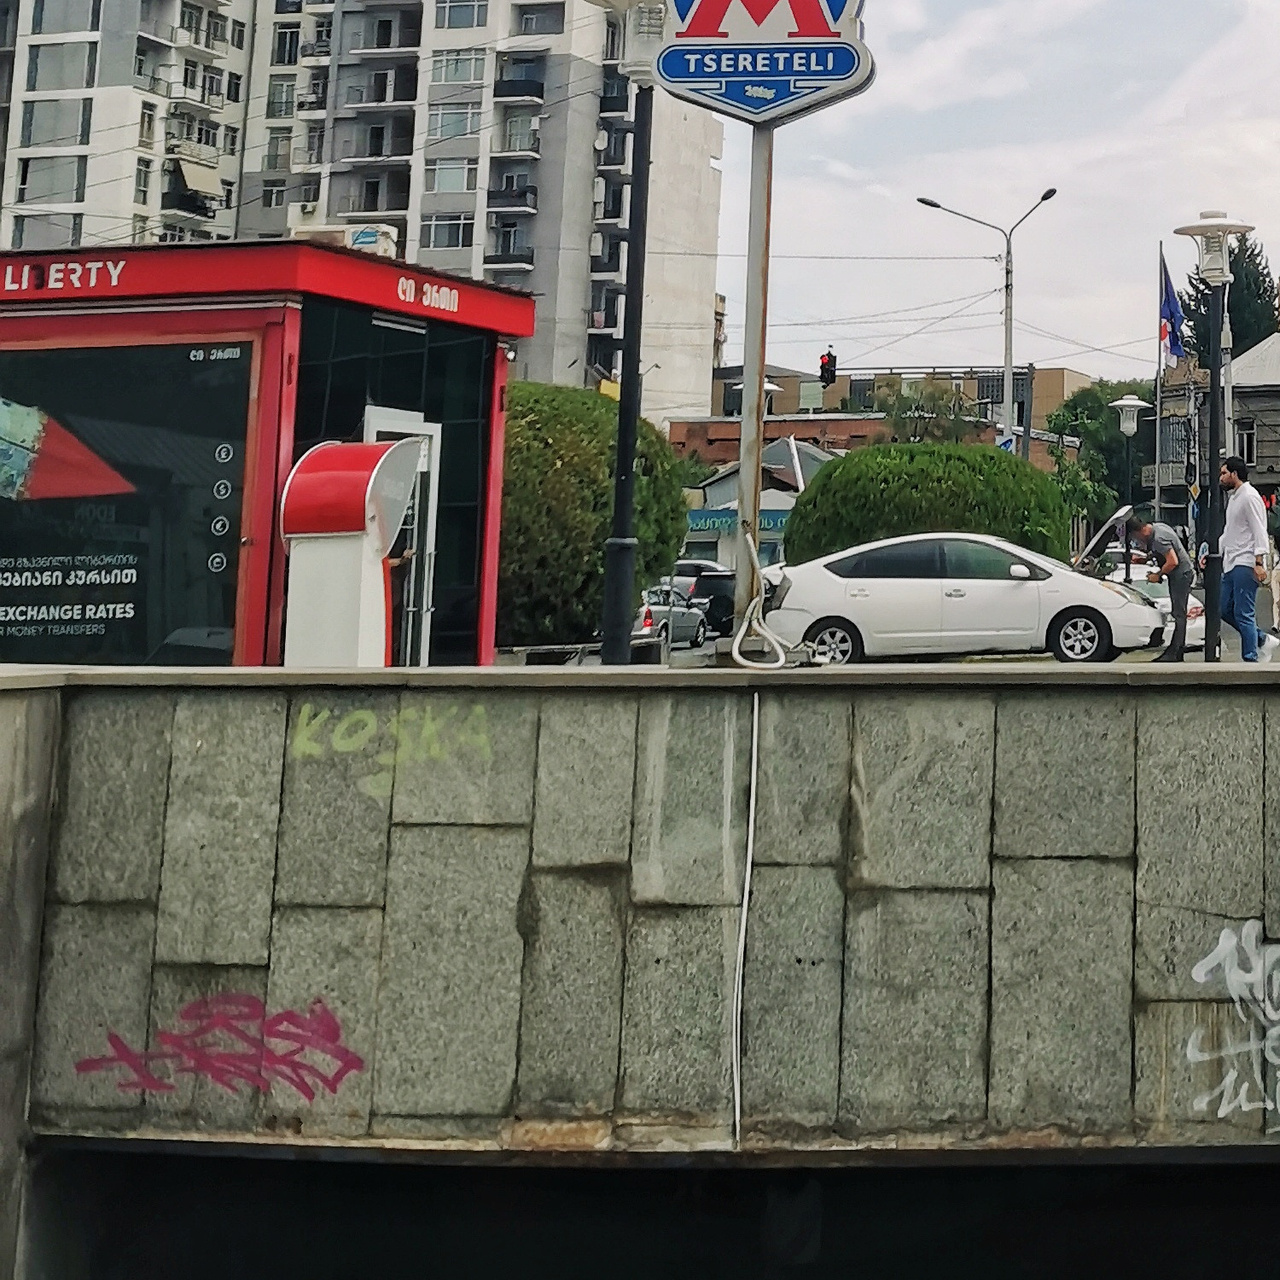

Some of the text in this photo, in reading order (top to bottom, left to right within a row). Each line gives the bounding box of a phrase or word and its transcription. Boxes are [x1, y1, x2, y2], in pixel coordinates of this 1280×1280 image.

[683, 51, 834, 73] TSERETELI
[397, 276, 459, 313] ლიერთი
[189, 346, 241, 362] ლიერთი
[0, 567, 138, 587] ებიანი კურსით
[0, 602, 136, 621] EXCHANGE RATES
[6, 625, 44, 637] MONEY
[47, 623, 107, 636] TRANSFERS
